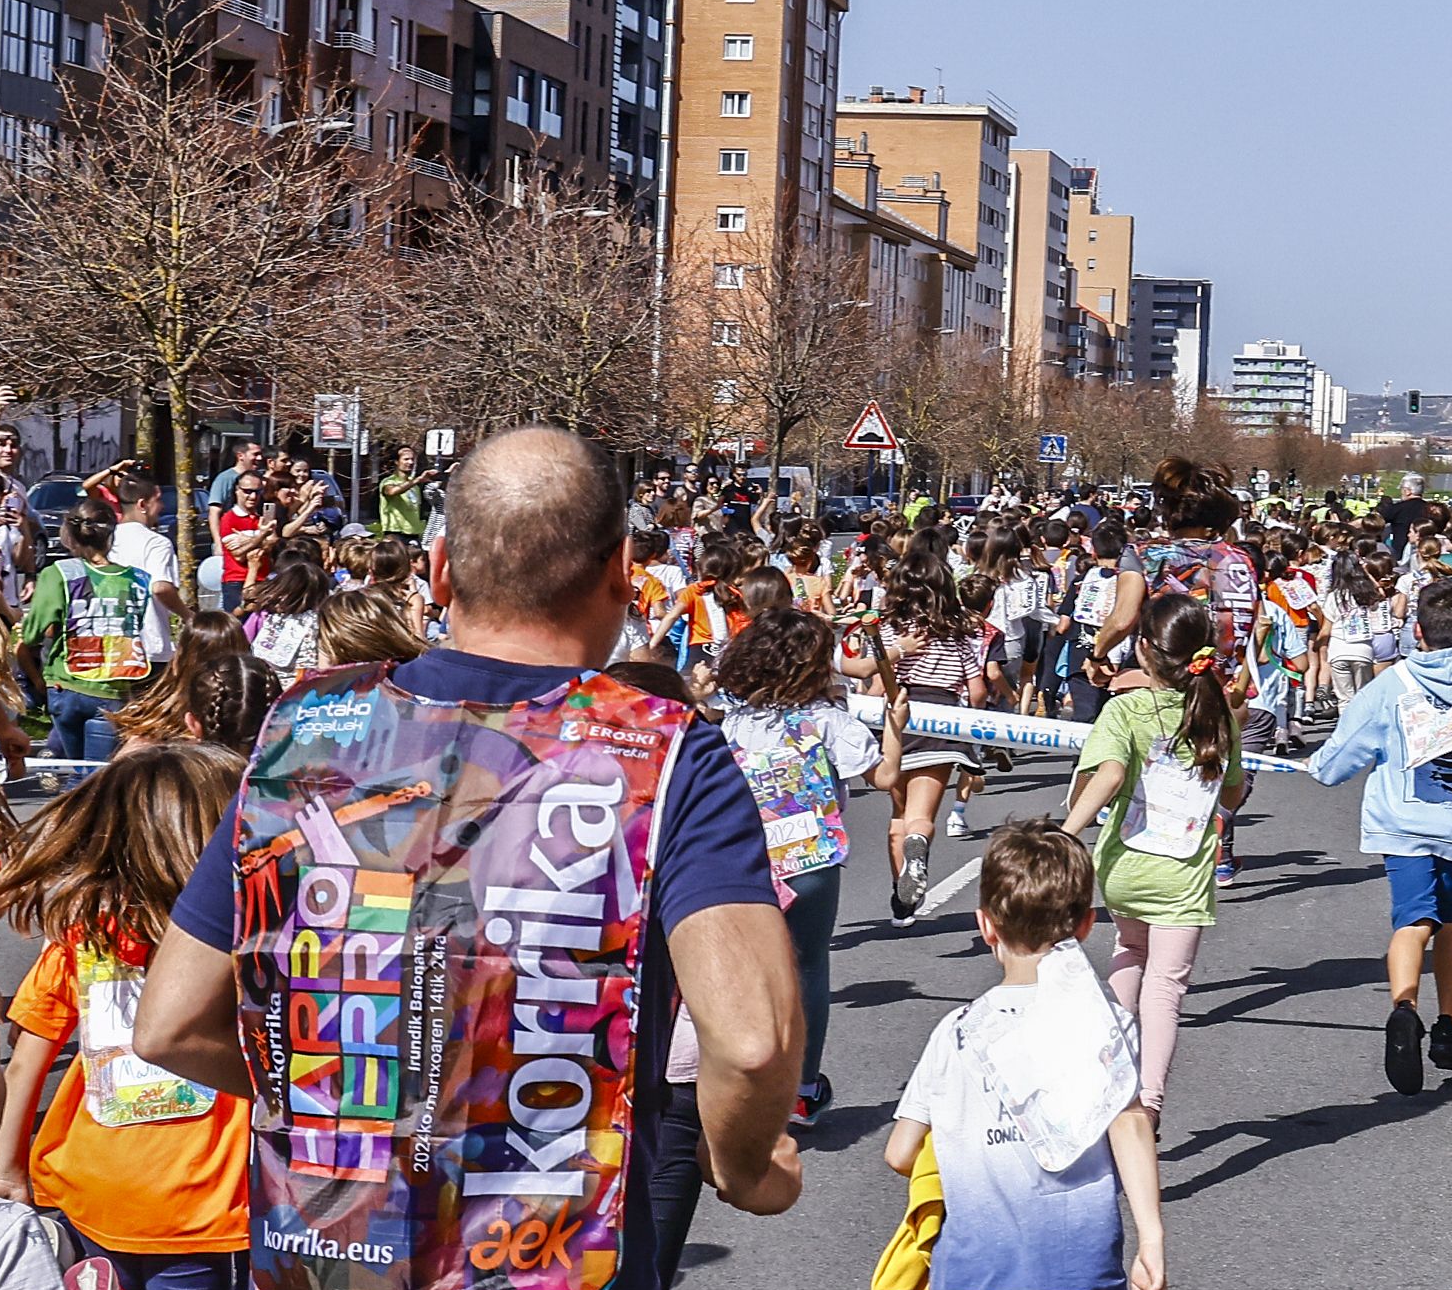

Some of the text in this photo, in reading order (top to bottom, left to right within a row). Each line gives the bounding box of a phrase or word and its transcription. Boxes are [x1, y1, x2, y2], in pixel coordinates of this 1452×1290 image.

[588, 724, 657, 747] EROSKI
[288, 864, 354, 1177] HARRO
[462, 777, 624, 1197] korrika
[335, 870, 414, 1184] HERRI
[407, 1015, 422, 1073] Irundik
[263, 1220, 395, 1264] korrika.eus
[469, 1198, 584, 1271] aek
